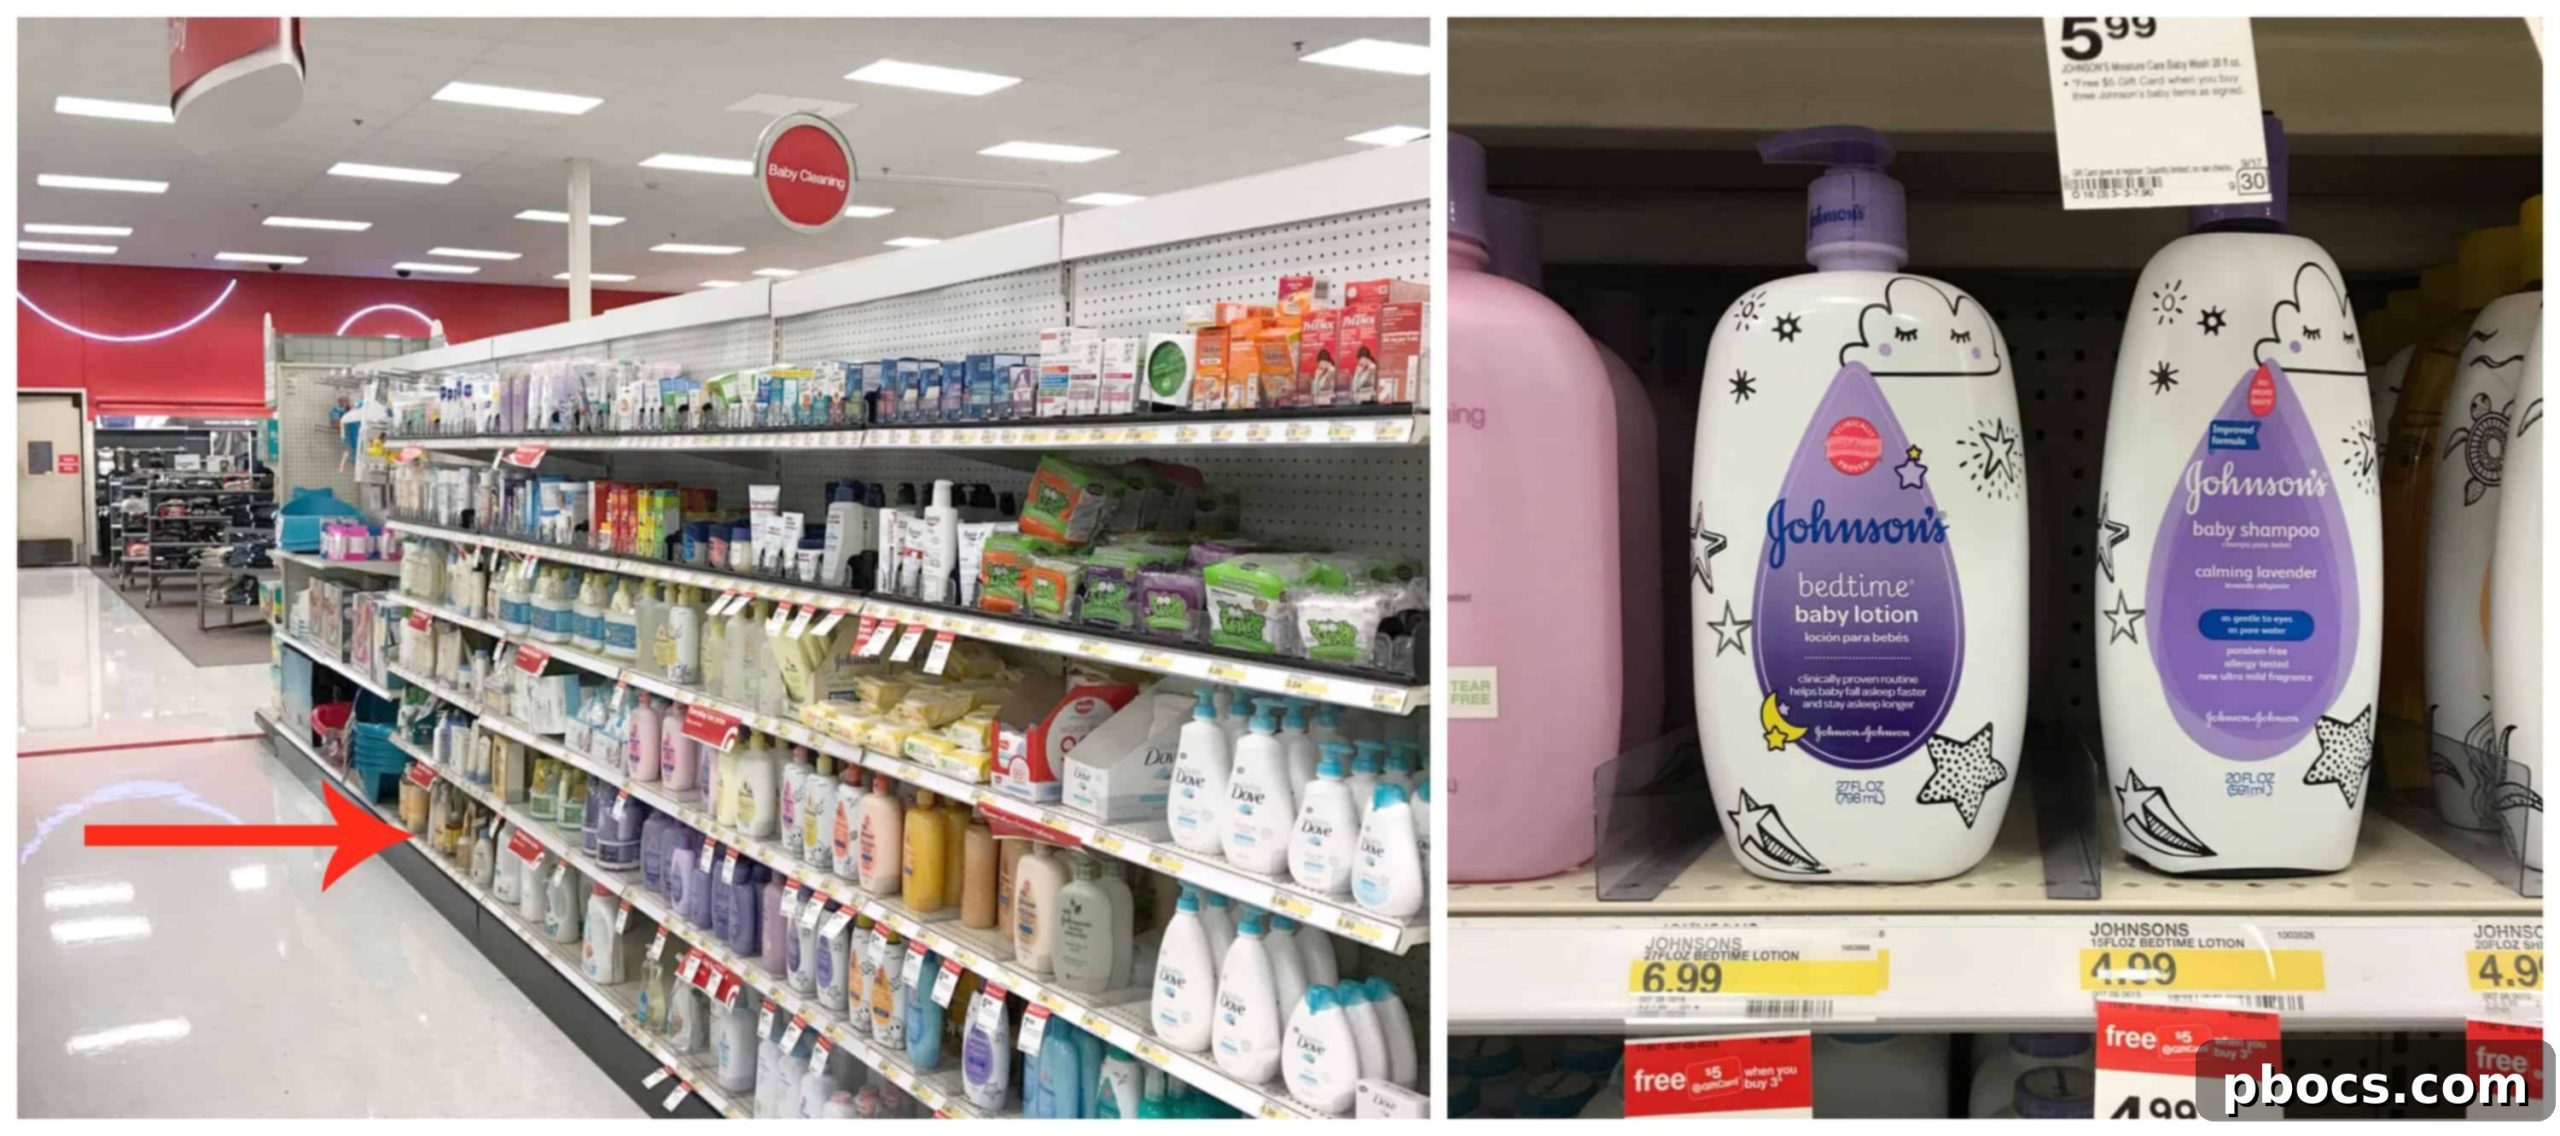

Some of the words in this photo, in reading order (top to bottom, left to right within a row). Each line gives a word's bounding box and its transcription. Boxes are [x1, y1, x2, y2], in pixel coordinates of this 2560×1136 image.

[2117, 75, 2136, 87] Gift
[2139, 75, 2165, 86] Card
[2168, 74, 2197, 85] when
[2199, 76, 2216, 87] you
[2218, 73, 2239, 86] buy
[2072, 90, 2096, 101] three
[2099, 88, 2145, 100] Johnson's
[2147, 87, 2170, 99] baby
[2172, 86, 2197, 97] items
[768, 163, 798, 182] Baby
[799, 168, 846, 192] Cleaning
[2239, 172, 2266, 190] 30
[2212, 424, 2255, 436] Improved
[2211, 435, 2247, 446] formula
[1837, 459, 1871, 471] PROVEN
[2185, 460, 2328, 515] Johnson's
[1767, 498, 1950, 569] Johnson's
[2193, 521, 2236, 541] baby
[2240, 521, 2320, 541] shampoo
[2195, 565, 2254, 581] calming
[2256, 566, 2318, 579] lavender
[1798, 572, 1911, 598] bedtime
[1795, 605, 1849, 627] baby
[1853, 605, 1918, 623] lotion
[2233, 614, 2261, 624] gentle
[2273, 616, 2294, 625] eyes
[1804, 632, 1841, 643] loción
[1842, 633, 1871, 644] para
[1872, 632, 1910, 643] bebés
[2239, 627, 2259, 637] pure
[2261, 627, 2287, 635] water
[2226, 646, 2288, 657] paraben-free
[2224, 659, 2257, 671] allergy
[2259, 659, 2290, 669] tested
[1797, 674, 1842, 686] clinically
[1843, 675, 1879, 687] proven
[1880, 674, 1919, 684] routine
[2197, 673, 2218, 681] new
[2220, 672, 2243, 681] ultra
[2245, 672, 2266, 682] mild
[2268, 672, 2314, 683] fragrance
[1450, 680, 1491, 693] TEAR
[1789, 687, 1818, 698] helps
[1818, 687, 1843, 698] baby
[1844, 687, 1861, 697] fall
[1861, 687, 1896, 698] asleep
[1897, 687, 1928, 697] faster
[1450, 693, 1491, 706] FREE
[1802, 699, 1820, 709] and
[1821, 700, 1844, 711] stay
[1846, 700, 1881, 711] asleep
[1882, 699, 1915, 711] longer
[1175, 767, 1206, 788] Dove
[1231, 782, 1266, 805] Dove
[1301, 819, 1333, 837] Dove
[1361, 837, 1385, 858] Dove
[2090, 922, 2190, 937] JOHNSONS
[1645, 937, 1743, 952] JOHNSONS
[2091, 938, 2137, 948] 15FLOZ
[2139, 938, 2195, 948] BEDTIME
[2198, 938, 2246, 949] LOTION
[2475, 940, 2519, 950] 20FLOZ
[1643, 950, 1692, 961] 27FLOZ
[1693, 950, 1749, 961] BEDTIME
[1752, 950, 1800, 962] LOTION
[1160, 965, 1187, 989] Dove
[1642, 962, 1723, 993] 6.99
[2479, 954, 2543, 988] 4.9
[1220, 990, 1247, 1016] Dove
[1297, 1033, 1327, 1055] Dove
[2105, 1025, 2157, 1050] free
[2175, 1030, 2193, 1043] $5
[2213, 1034, 2244, 1048] when
[2246, 1039, 2267, 1051] you
[2213, 1048, 2238, 1061] buy
[2475, 1046, 2529, 1074] free
[1704, 1066, 1723, 1080] $5
[1744, 1066, 1775, 1077] when
[1776, 1065, 1798, 1079] you
[1633, 1069, 1687, 1093] free
[1743, 1077, 1768, 1091] buy
